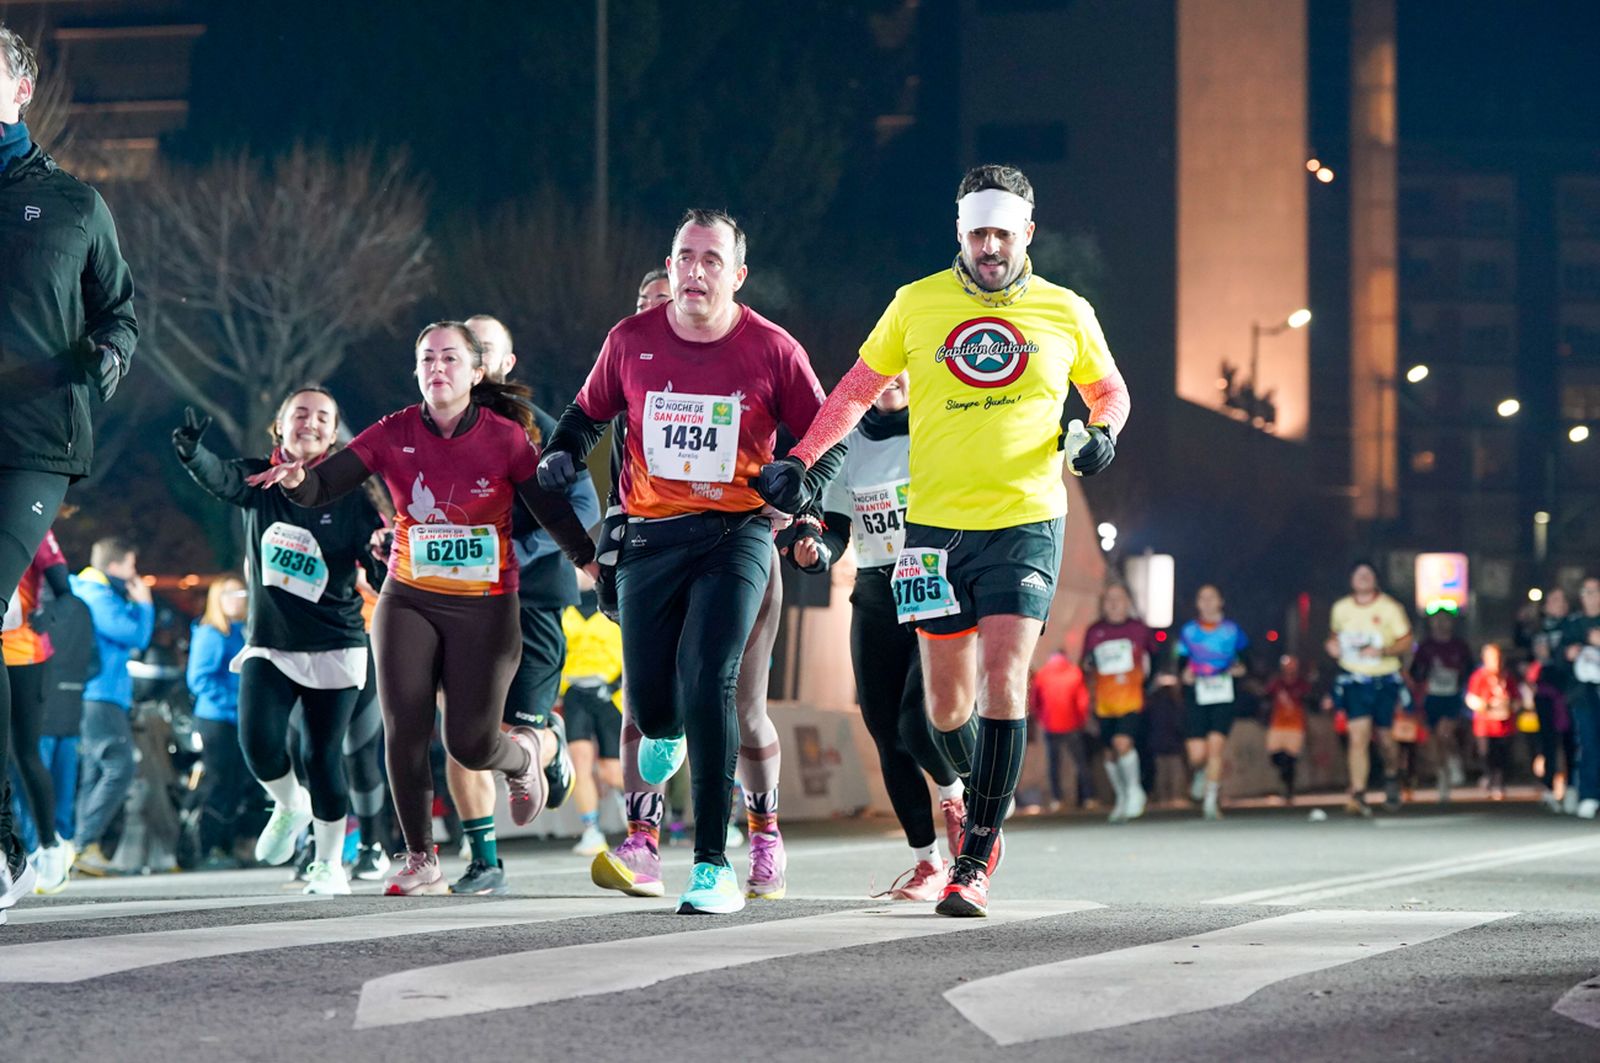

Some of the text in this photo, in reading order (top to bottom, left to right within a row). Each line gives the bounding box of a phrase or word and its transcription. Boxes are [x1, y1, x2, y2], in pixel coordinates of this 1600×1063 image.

[935, 340, 1039, 363] Capitán Antonio
[665, 402, 693, 412] NOCHE
[693, 405, 704, 413] DE
[945, 400, 980, 411] Siempre
[654, 411, 672, 421] SAN
[673, 412, 704, 424] ANTÓN
[662, 424, 718, 452] 1434
[879, 491, 889, 500] DE
[427, 538, 483, 562] 6205
[271, 546, 317, 576] 7836
